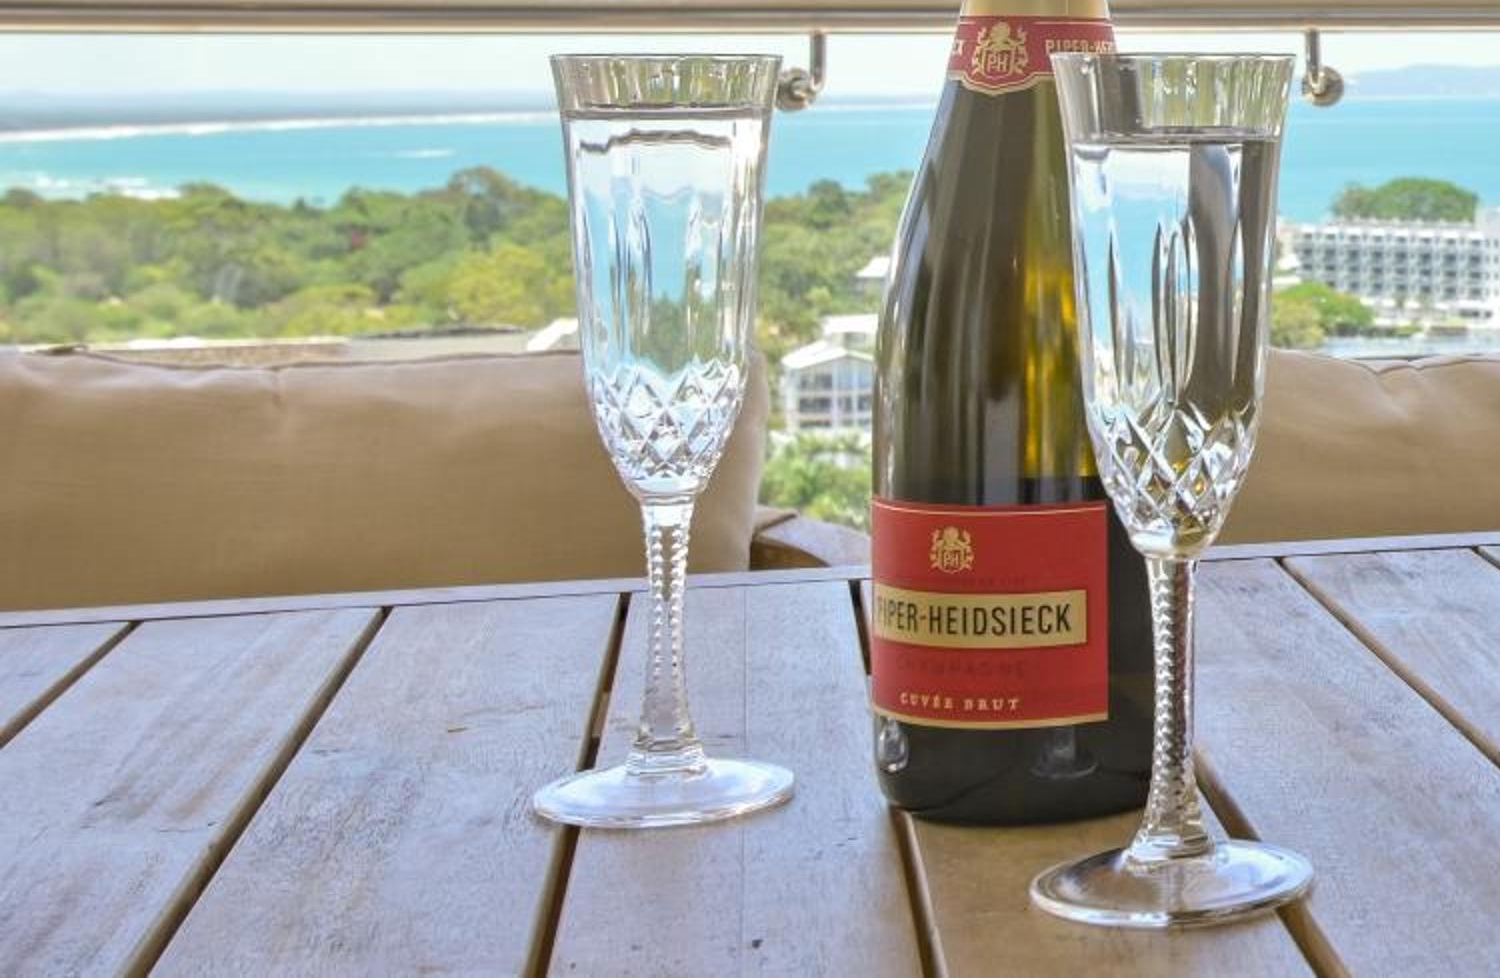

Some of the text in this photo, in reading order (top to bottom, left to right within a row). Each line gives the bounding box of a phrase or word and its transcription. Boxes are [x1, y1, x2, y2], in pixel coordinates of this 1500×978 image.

[988, 52, 1010, 72] PH
[877, 595, 1072, 636] PIPER-HEIDSIECK
[899, 691, 1020, 711] CUVÉE BRUT
